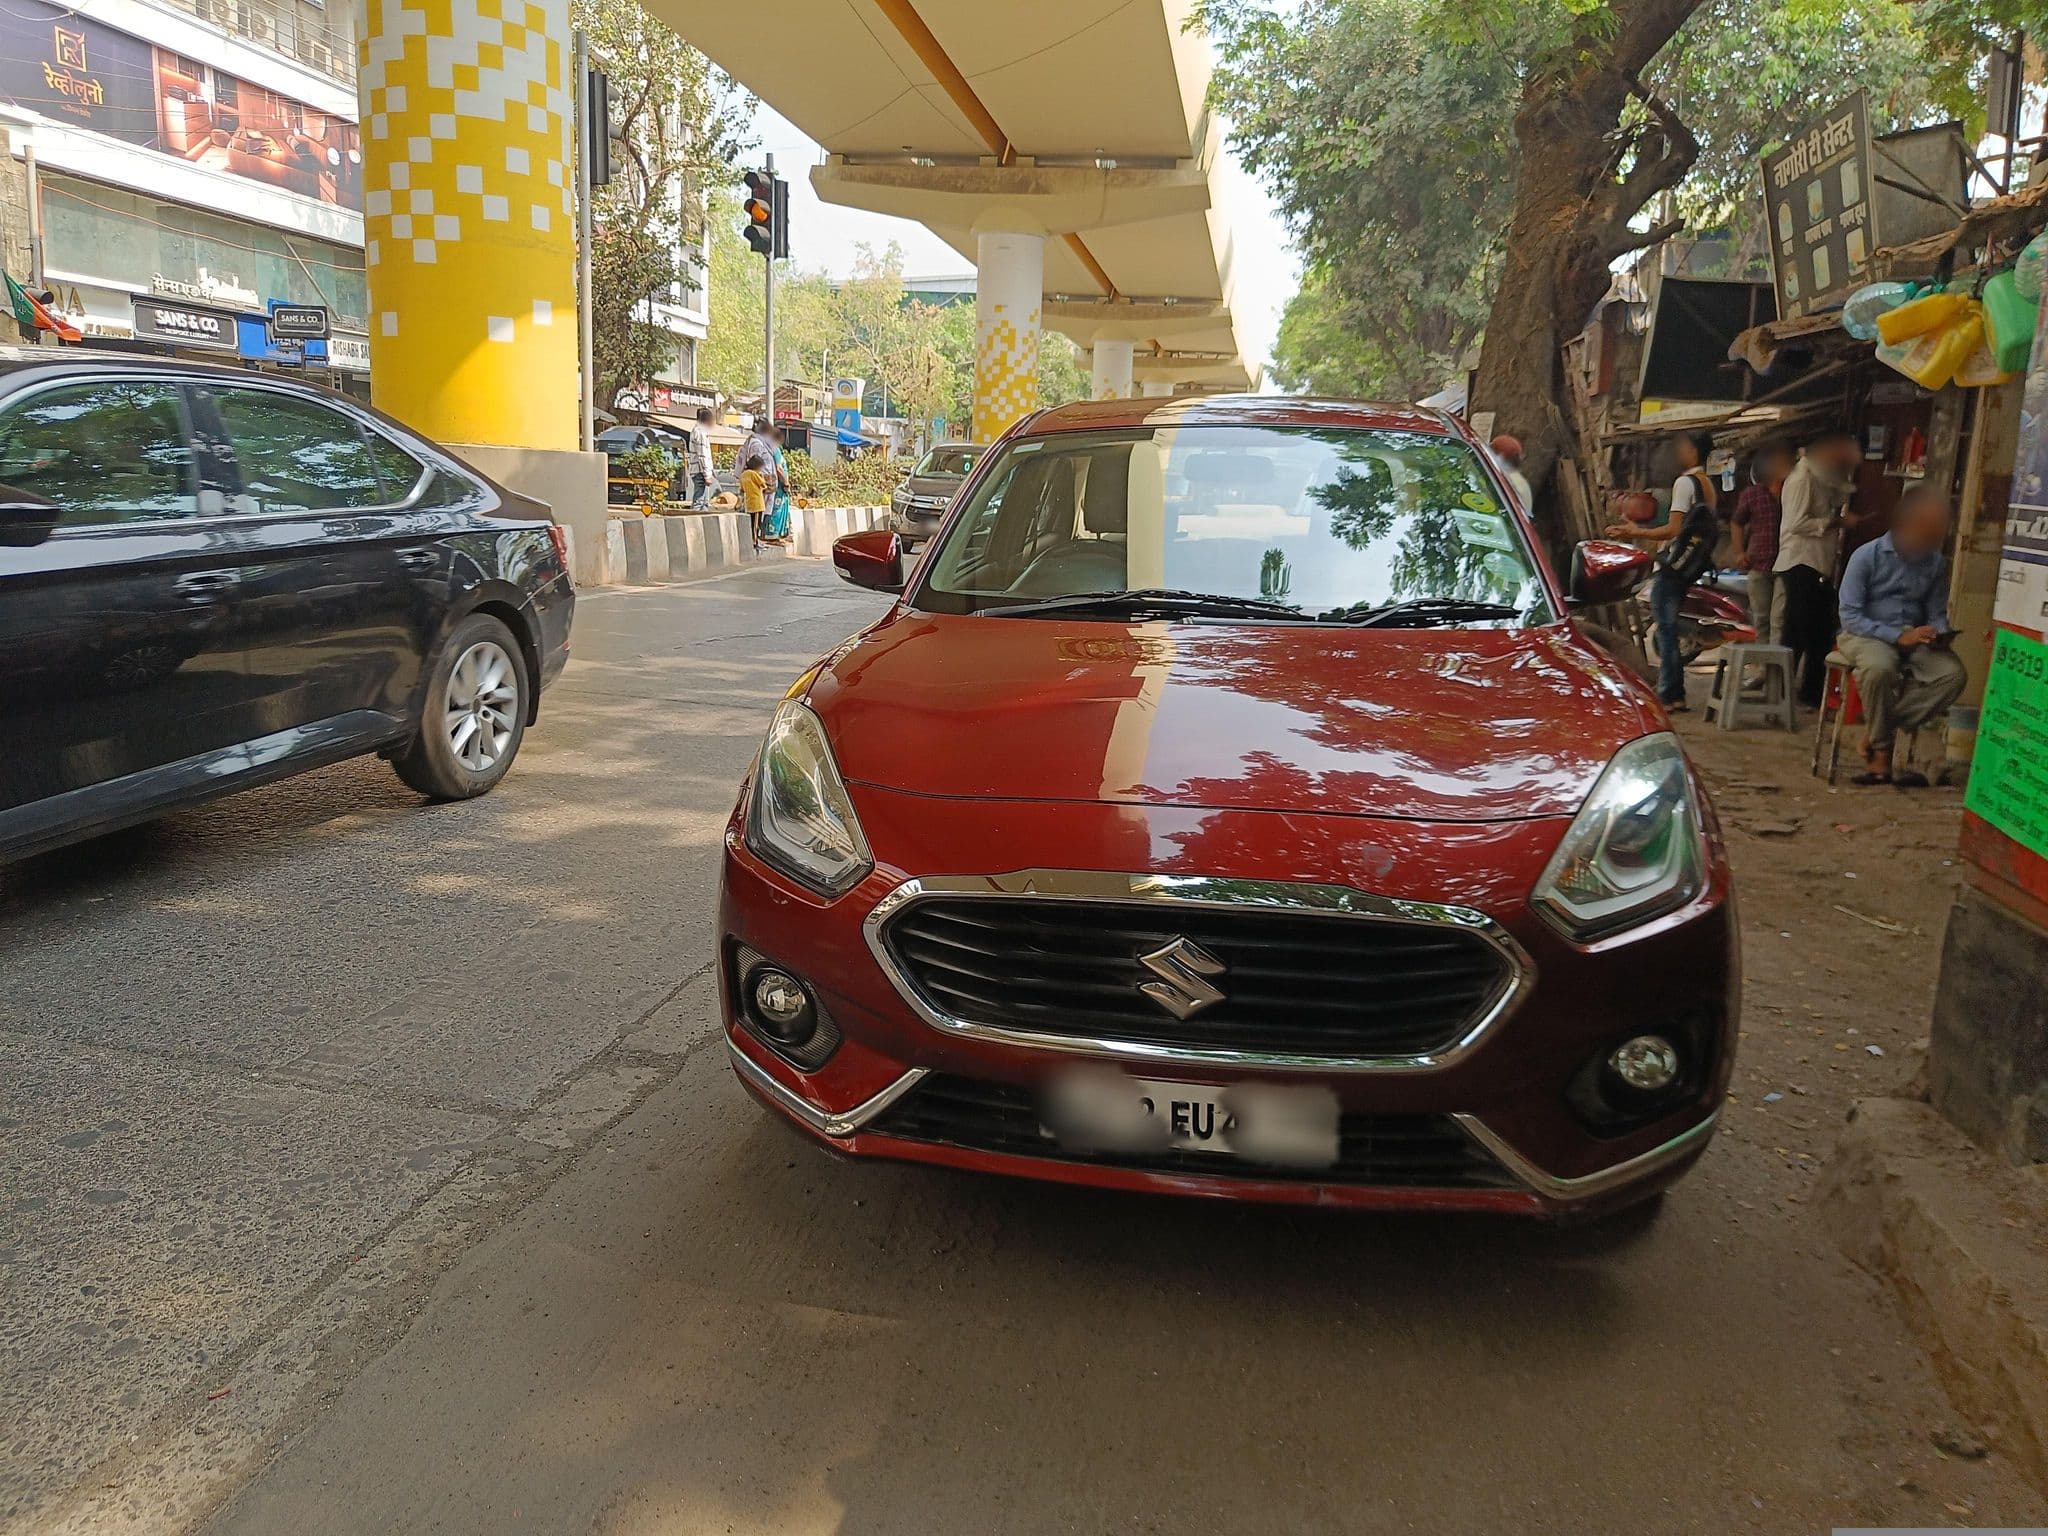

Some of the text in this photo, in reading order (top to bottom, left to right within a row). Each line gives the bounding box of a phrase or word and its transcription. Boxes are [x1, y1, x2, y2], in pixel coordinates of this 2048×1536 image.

[1808, 128, 1822, 167] टी
[154, 309, 188, 328] SANS
[188, 315, 200, 330] &
[281, 314, 299, 323] SANS
[2007, 647, 2048, 685] 9819
